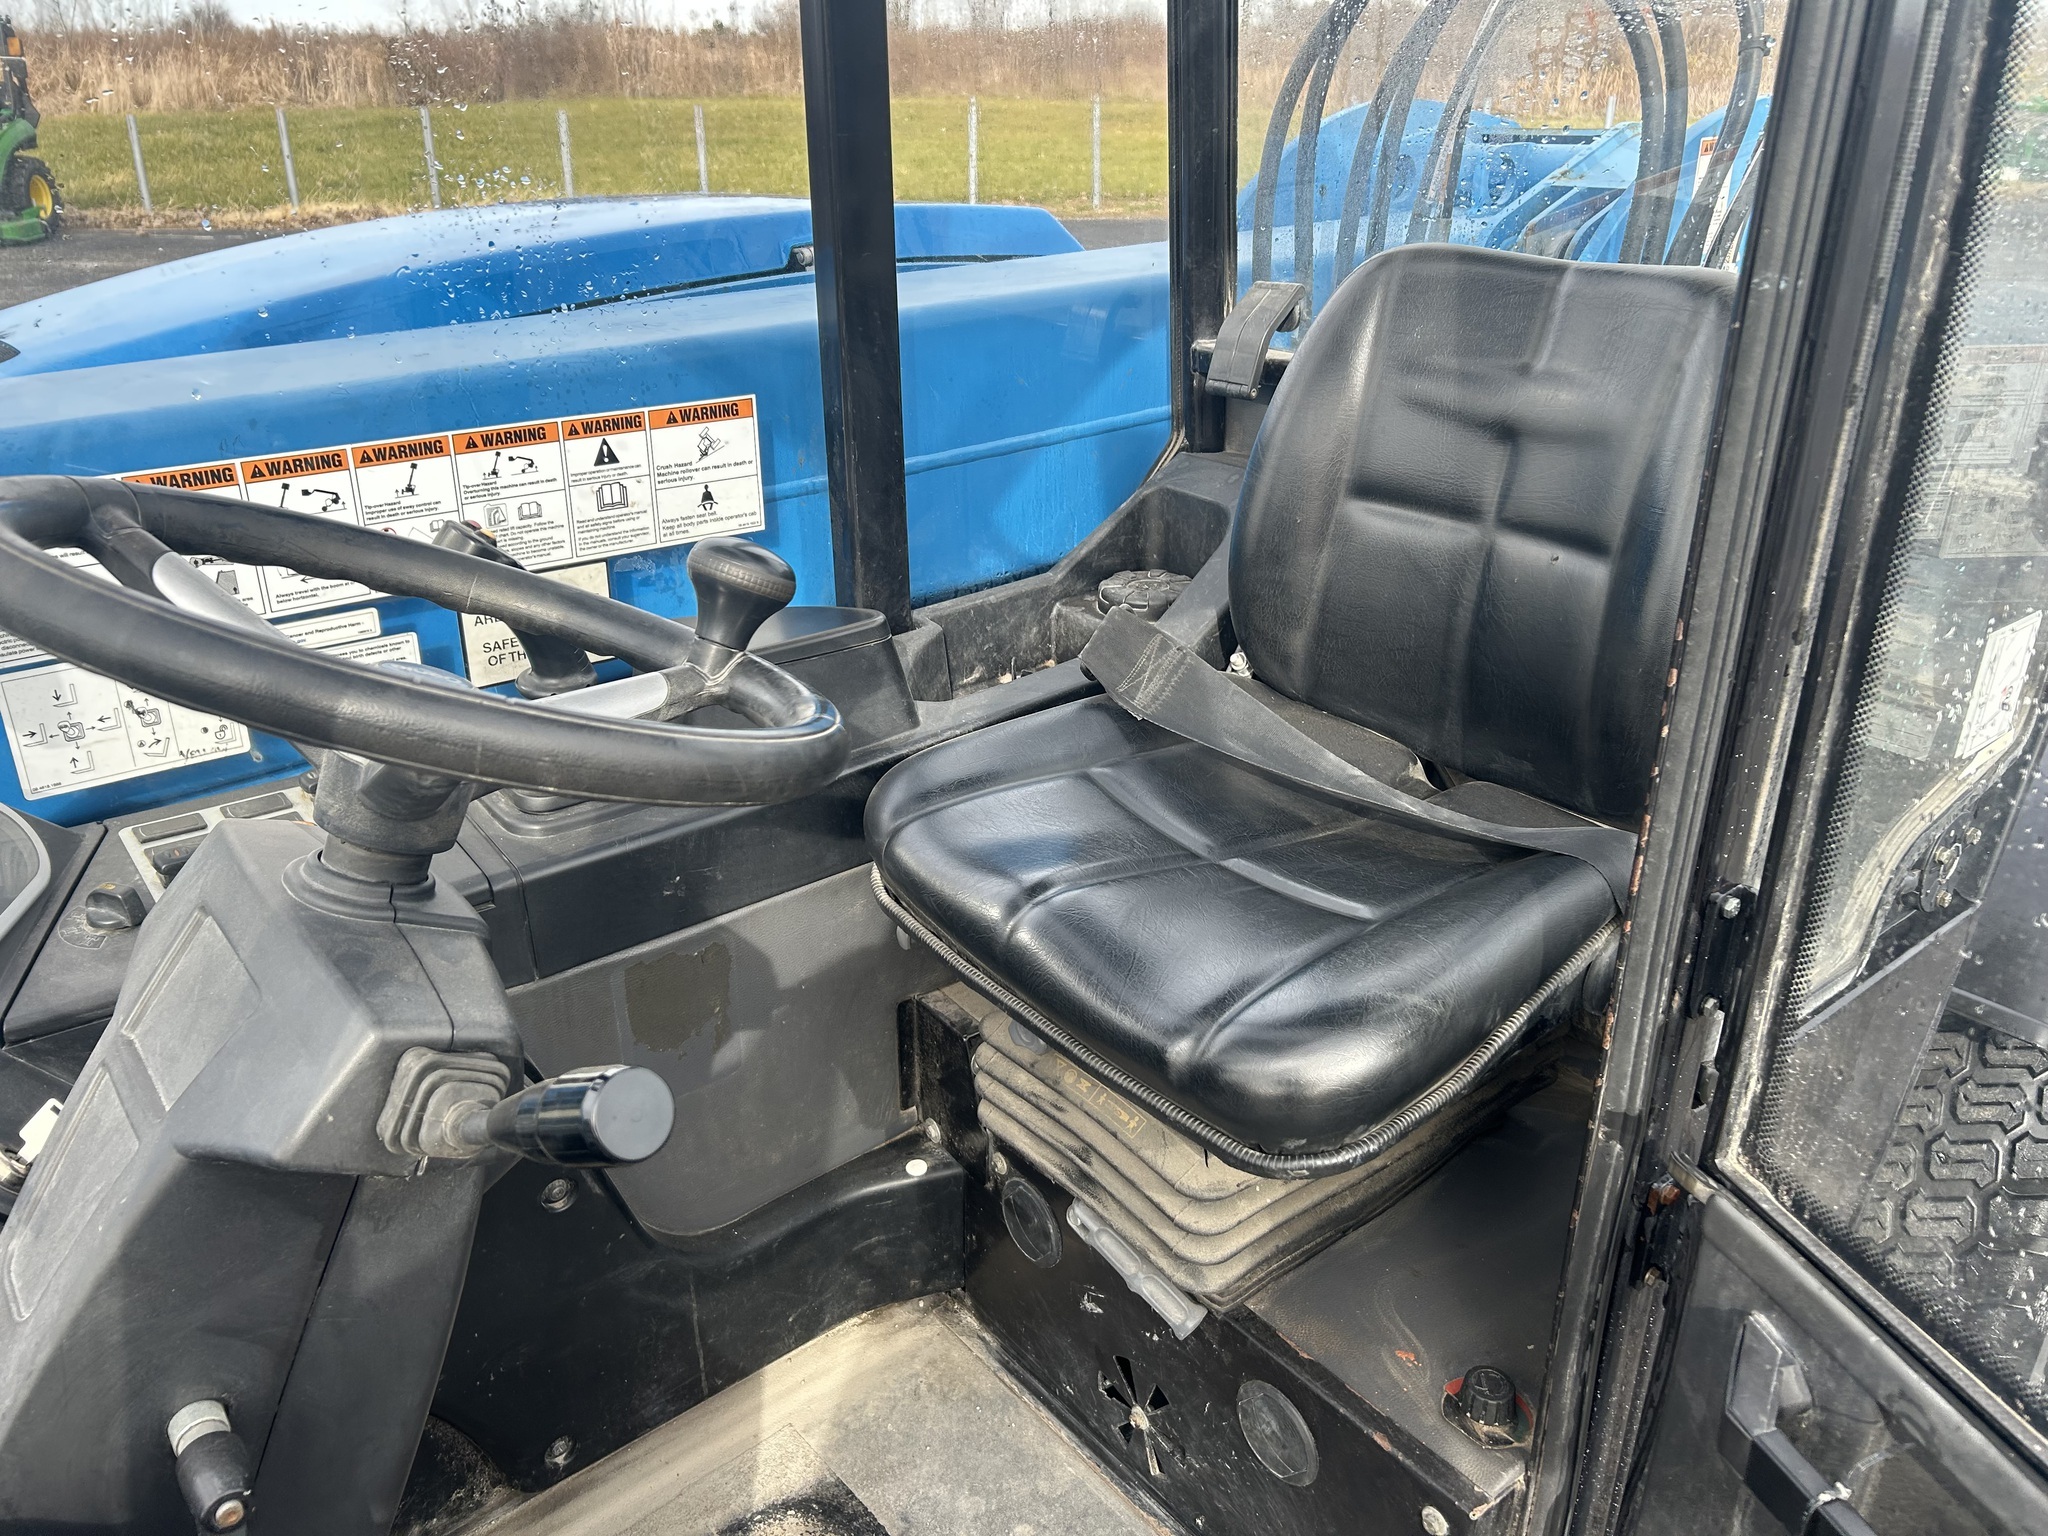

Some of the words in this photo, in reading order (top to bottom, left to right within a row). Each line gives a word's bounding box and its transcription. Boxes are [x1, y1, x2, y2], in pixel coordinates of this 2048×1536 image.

[679, 403, 739, 422] WARNING
[581, 415, 642, 434] WARNING
[480, 427, 546, 447] WARNING
[372, 440, 443, 461] WARNING
[265, 453, 343, 476] WARNING
[150, 468, 234, 489] WARNING
[679, 474, 695, 482] injury.
[464, 487, 490, 495] Overturning
[315, 624, 347, 634] Reproductive
[365, 643, 388, 652] chemicals
[483, 637, 519, 653] SAFE
[488, 653, 506, 666] OF
[508, 650, 527, 662] TH
